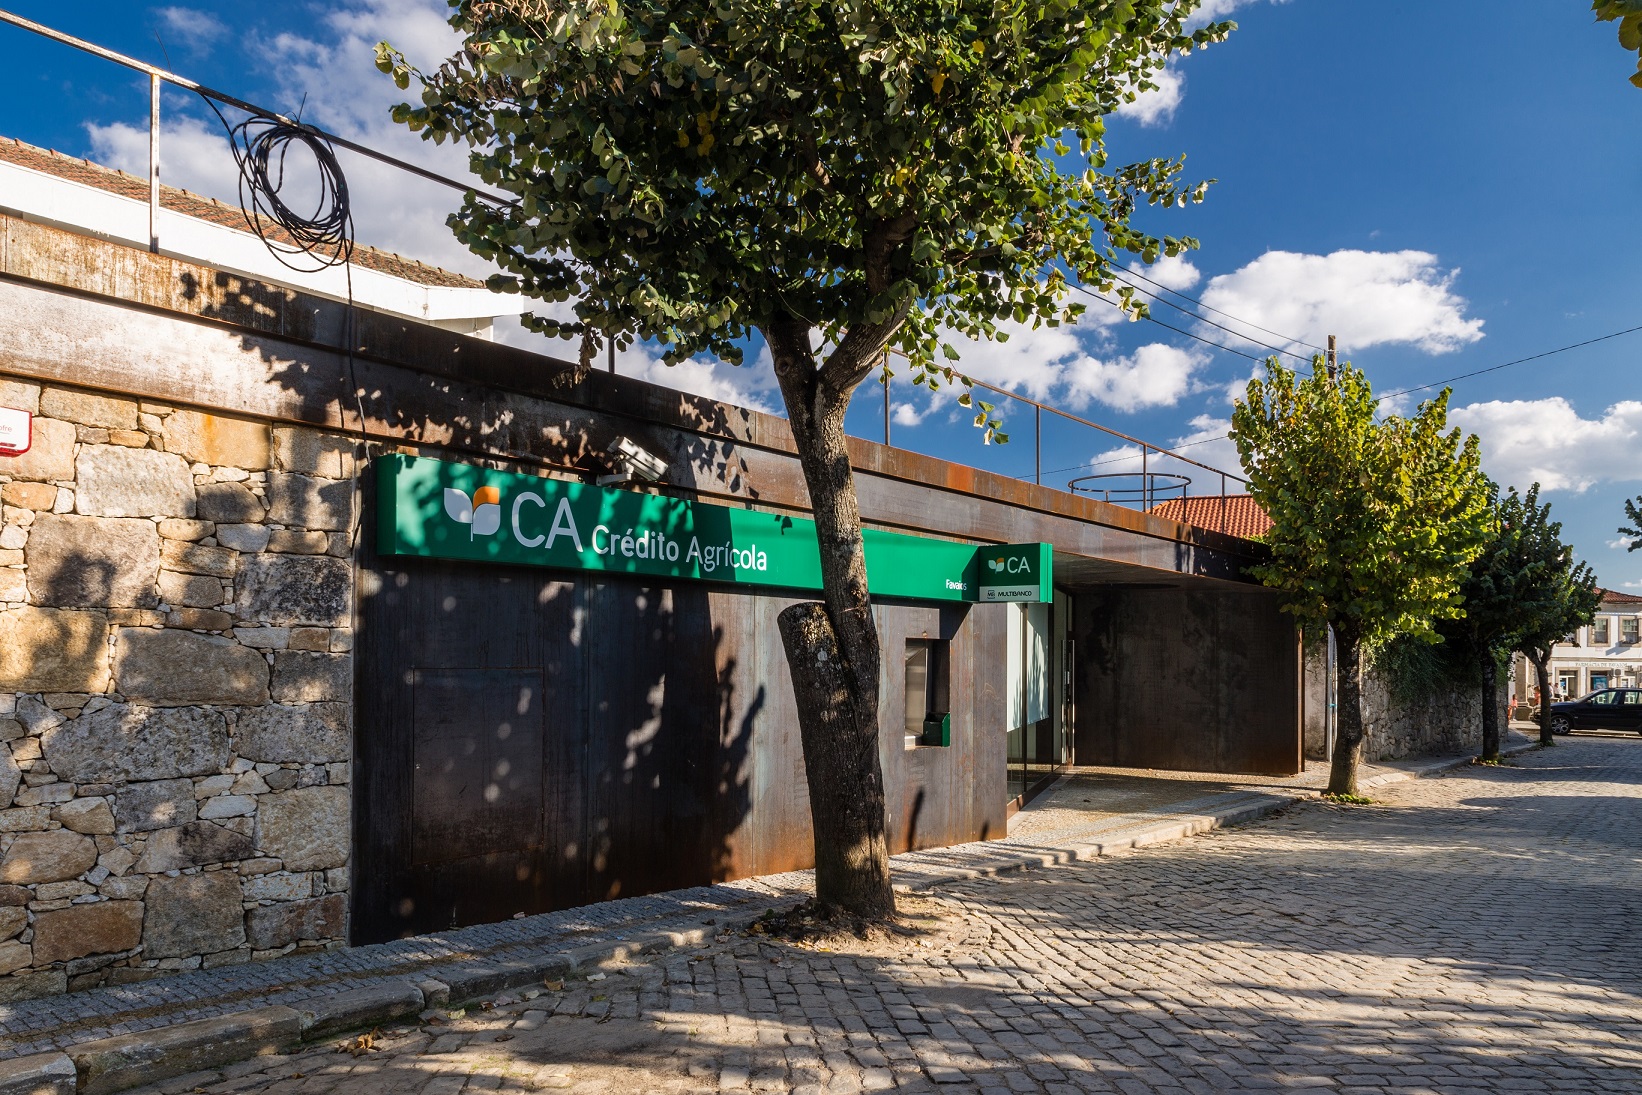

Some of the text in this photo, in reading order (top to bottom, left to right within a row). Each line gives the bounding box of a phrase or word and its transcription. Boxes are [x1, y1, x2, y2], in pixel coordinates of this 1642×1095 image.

[512, 491, 767, 572] CA Crédito Agrícola
[1007, 556, 1031, 574] CA
